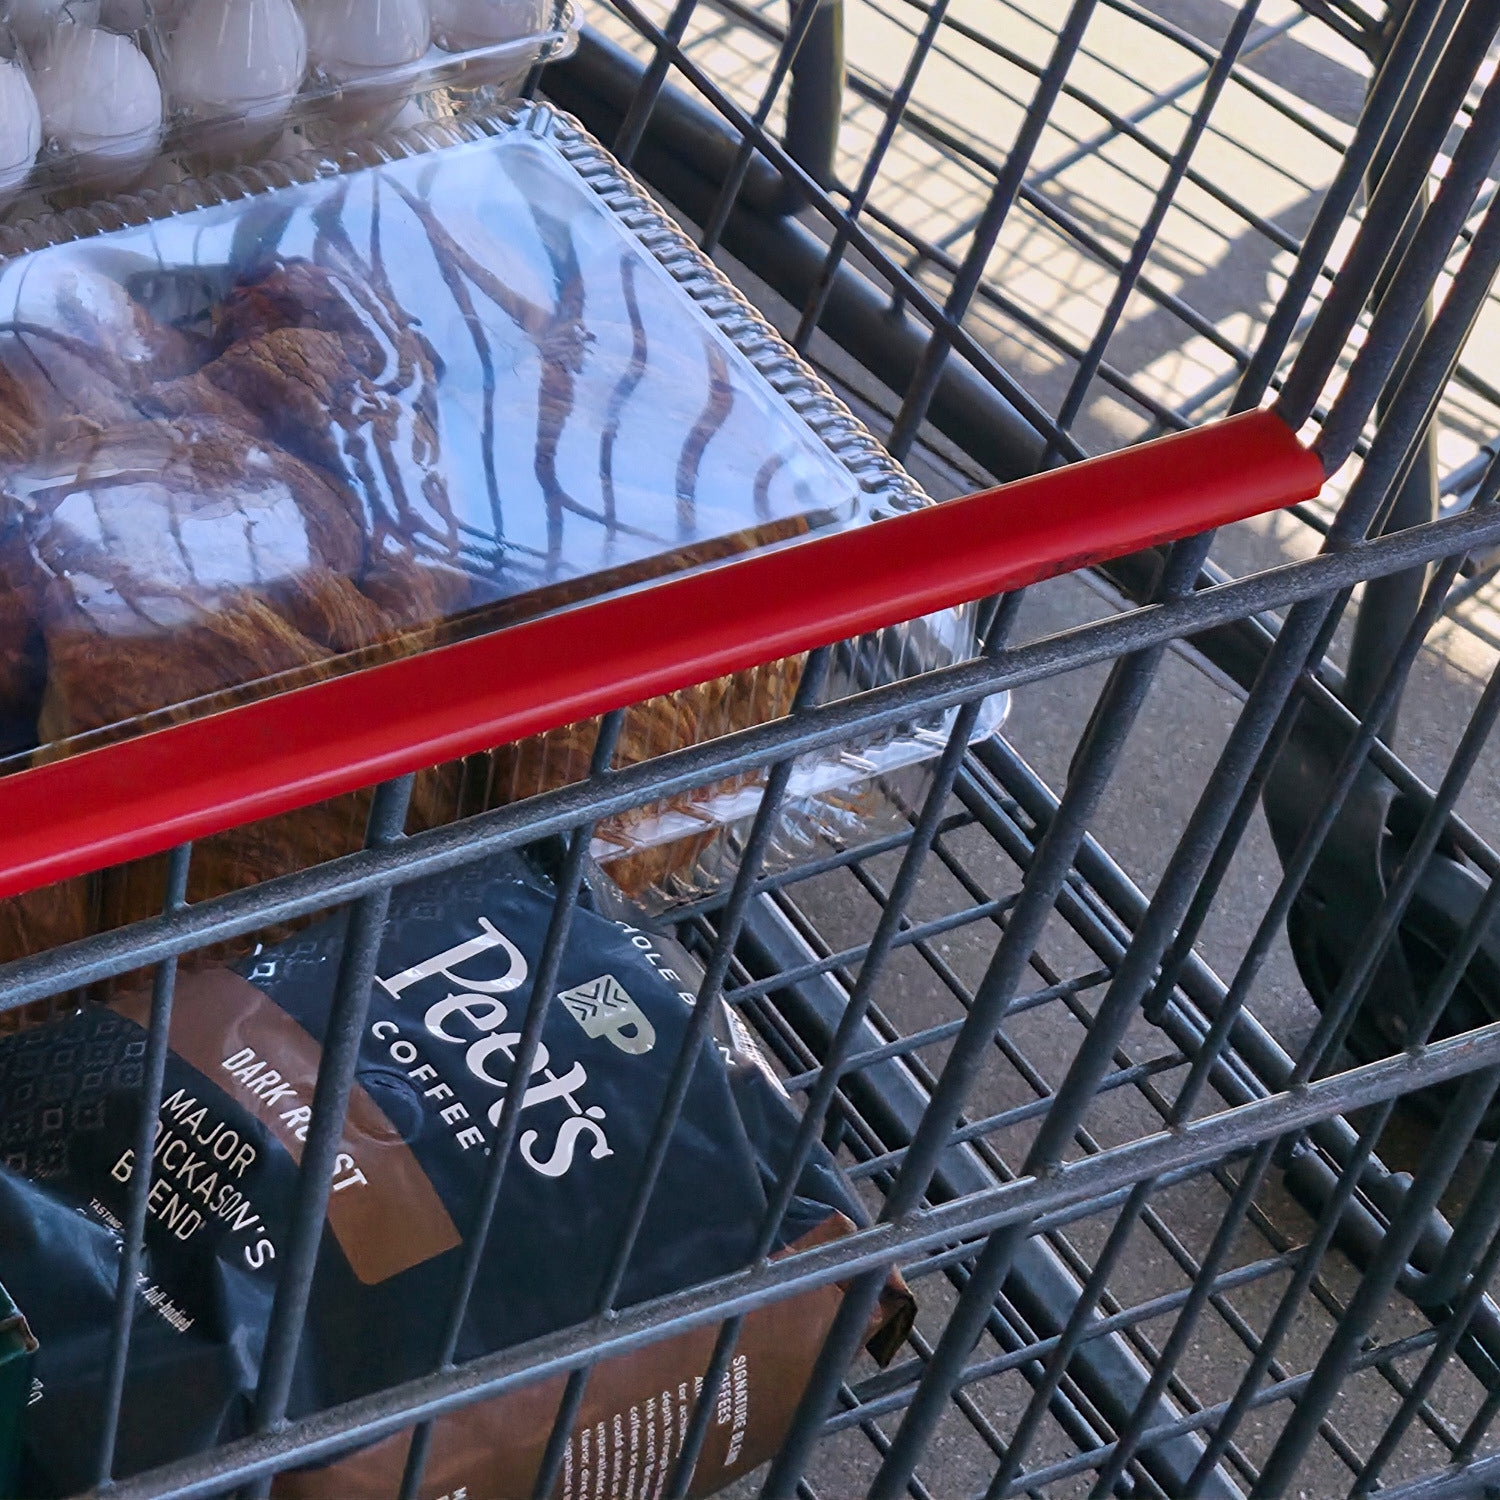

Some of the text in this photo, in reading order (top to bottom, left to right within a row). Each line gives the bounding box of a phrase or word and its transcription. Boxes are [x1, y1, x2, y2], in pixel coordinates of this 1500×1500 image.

[370, 1019, 486, 1150] COFFEE
[374, 916, 616, 1179] Peet's
[159, 1087, 256, 1178] MAJOR
[220, 1046, 370, 1193] DARK RST
[110, 1149, 206, 1242] BEND
